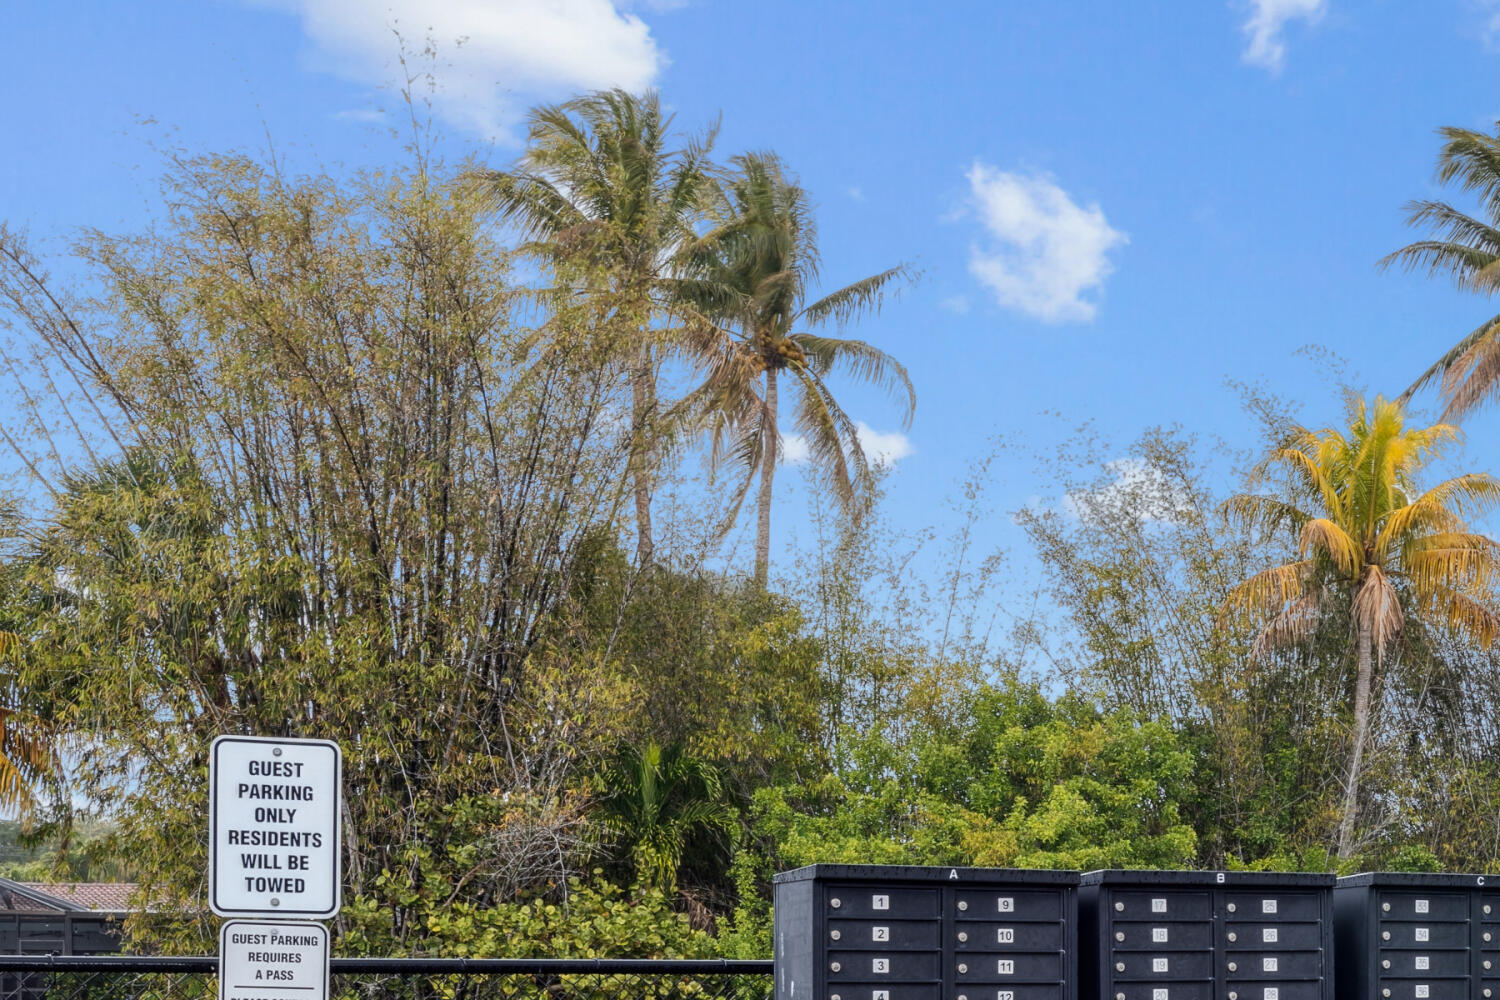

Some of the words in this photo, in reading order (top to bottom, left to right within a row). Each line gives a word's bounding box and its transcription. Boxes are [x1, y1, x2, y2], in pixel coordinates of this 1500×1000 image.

[248, 760, 304, 778] GUEST
[238, 784, 314, 802] PARKING
[254, 807, 297, 824] ONLY
[228, 830, 322, 848] RESIDENTS
[242, 854, 282, 870] WILL
[288, 856, 309, 871] BE
[949, 869, 958, 879] A
[1216, 873, 1225, 883] B
[245, 877, 305, 894] TOWED
[1477, 876, 1485, 886] C
[878, 898, 884, 908] 1
[1002, 900, 1010, 910] 9
[1154, 900, 1166, 910] 17
[877, 928, 884, 938] 2
[999, 930, 1012, 940] 10
[1154, 930, 1166, 940] 18
[1264, 930, 1276, 940] 26
[232, 934, 268, 946] GUEST
[271, 934, 318, 946] PARKING
[248, 952, 302, 964] REQUIRES
[877, 960, 884, 970] 3
[1000, 962, 1010, 972] 11
[1154, 960, 1166, 970] 19
[1264, 960, 1276, 970] 27
[256, 970, 263, 980] A
[266, 970, 294, 981] PASS
[1154, 990, 1166, 1000] 20
[1266, 990, 1276, 1000] 28
